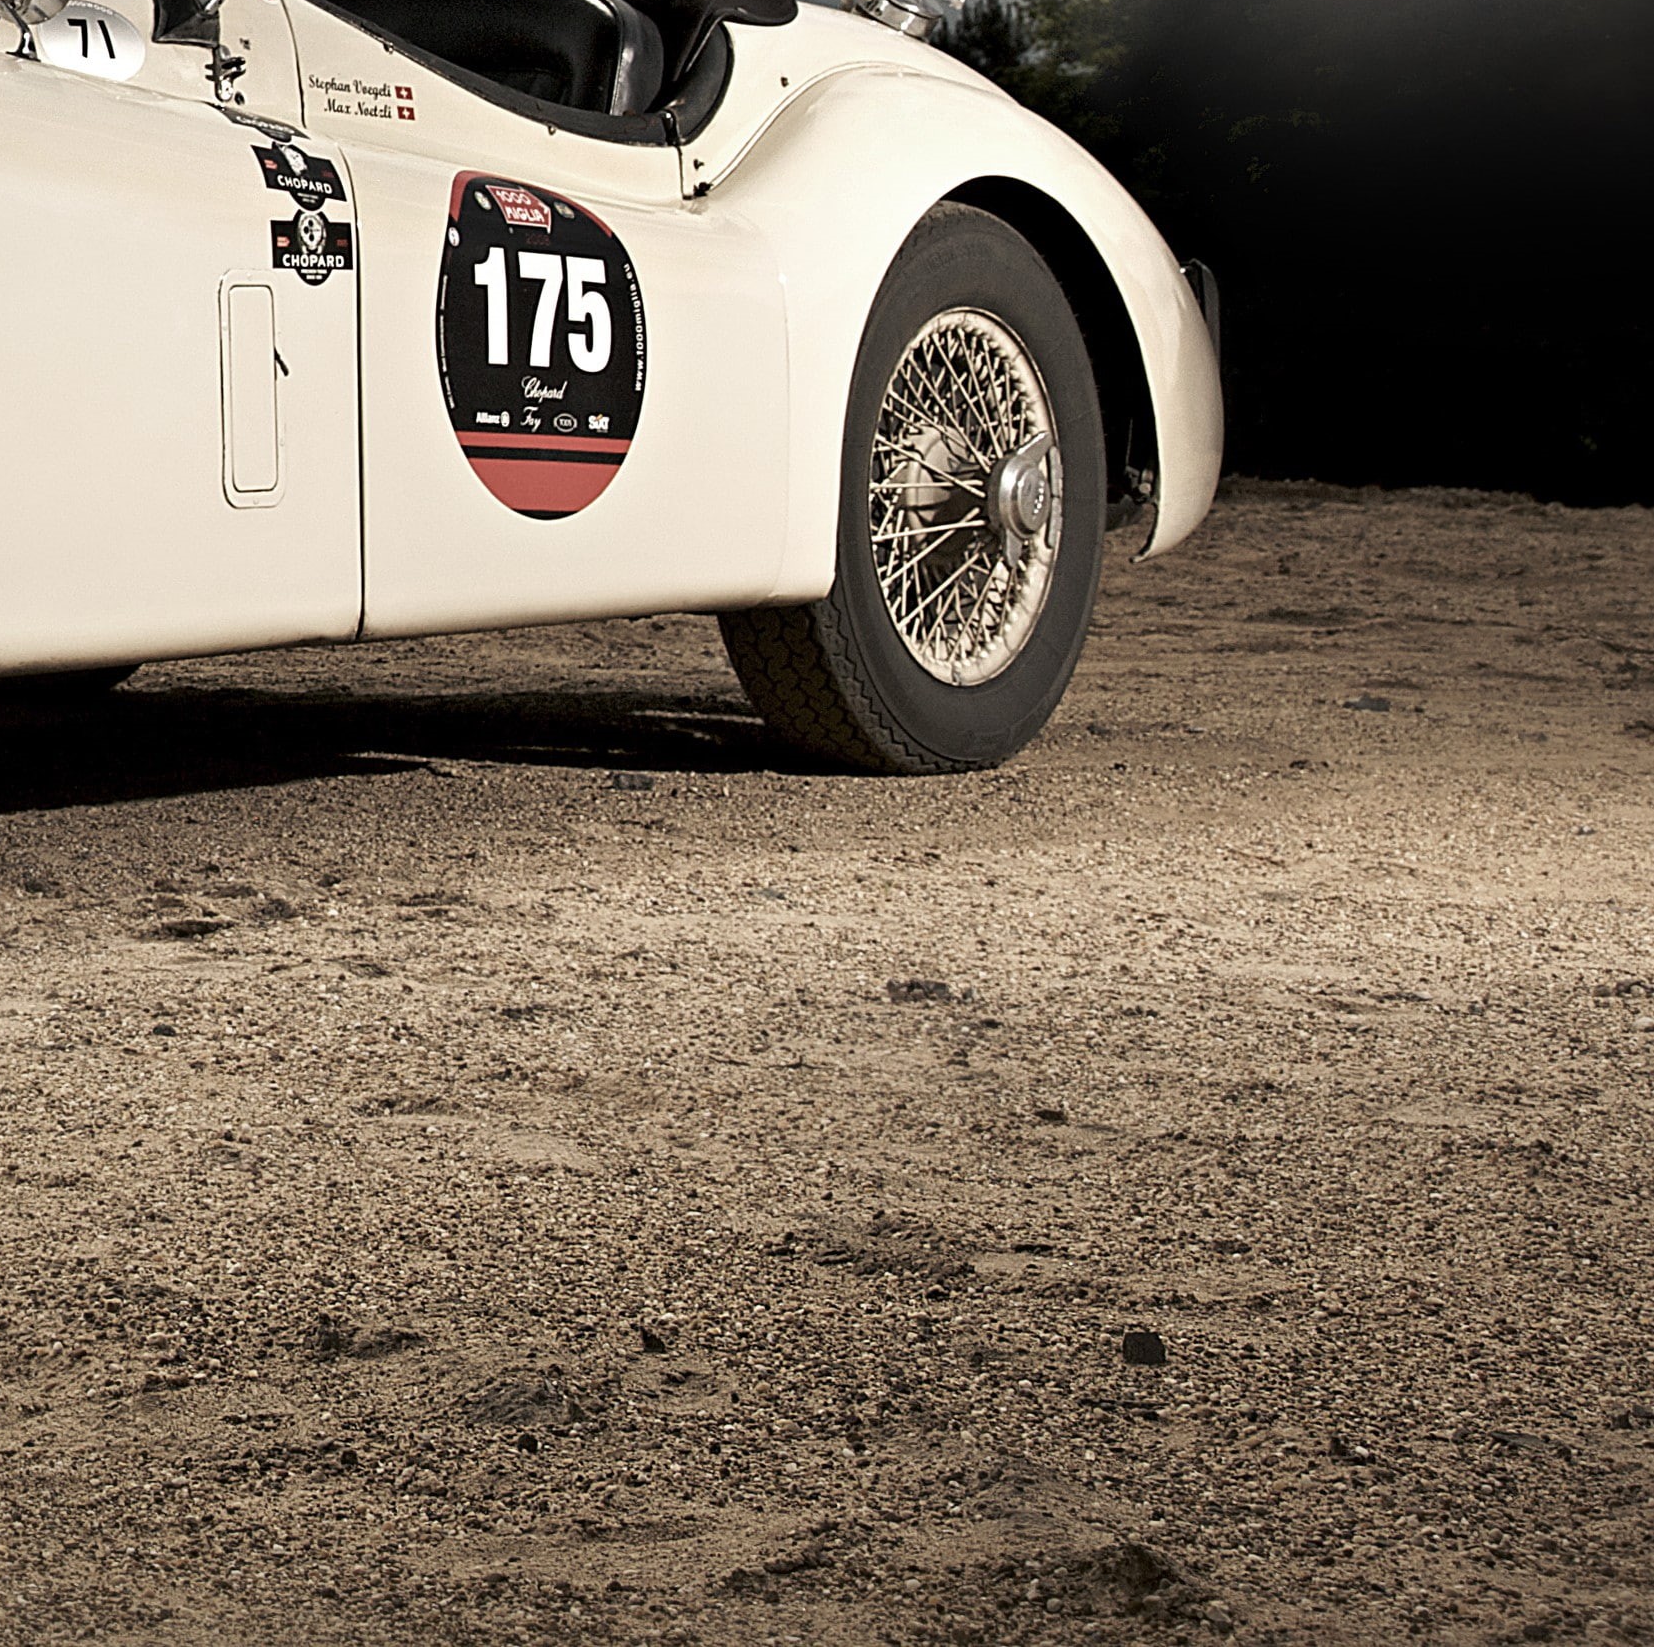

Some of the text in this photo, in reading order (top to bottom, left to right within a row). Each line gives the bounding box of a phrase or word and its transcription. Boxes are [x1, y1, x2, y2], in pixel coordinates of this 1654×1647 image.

[67, 18, 116, 59] 71
[308, 74, 351, 94] Stephan
[324, 98, 352, 114] Max
[277, 174, 333, 194] CHOPARD
[495, 189, 532, 205] 1000
[504, 206, 545, 223] MIGLIA
[282, 253, 345, 268] CHOPARD
[474, 246, 613, 373] 175
[521, 375, 568, 403] Chopard
